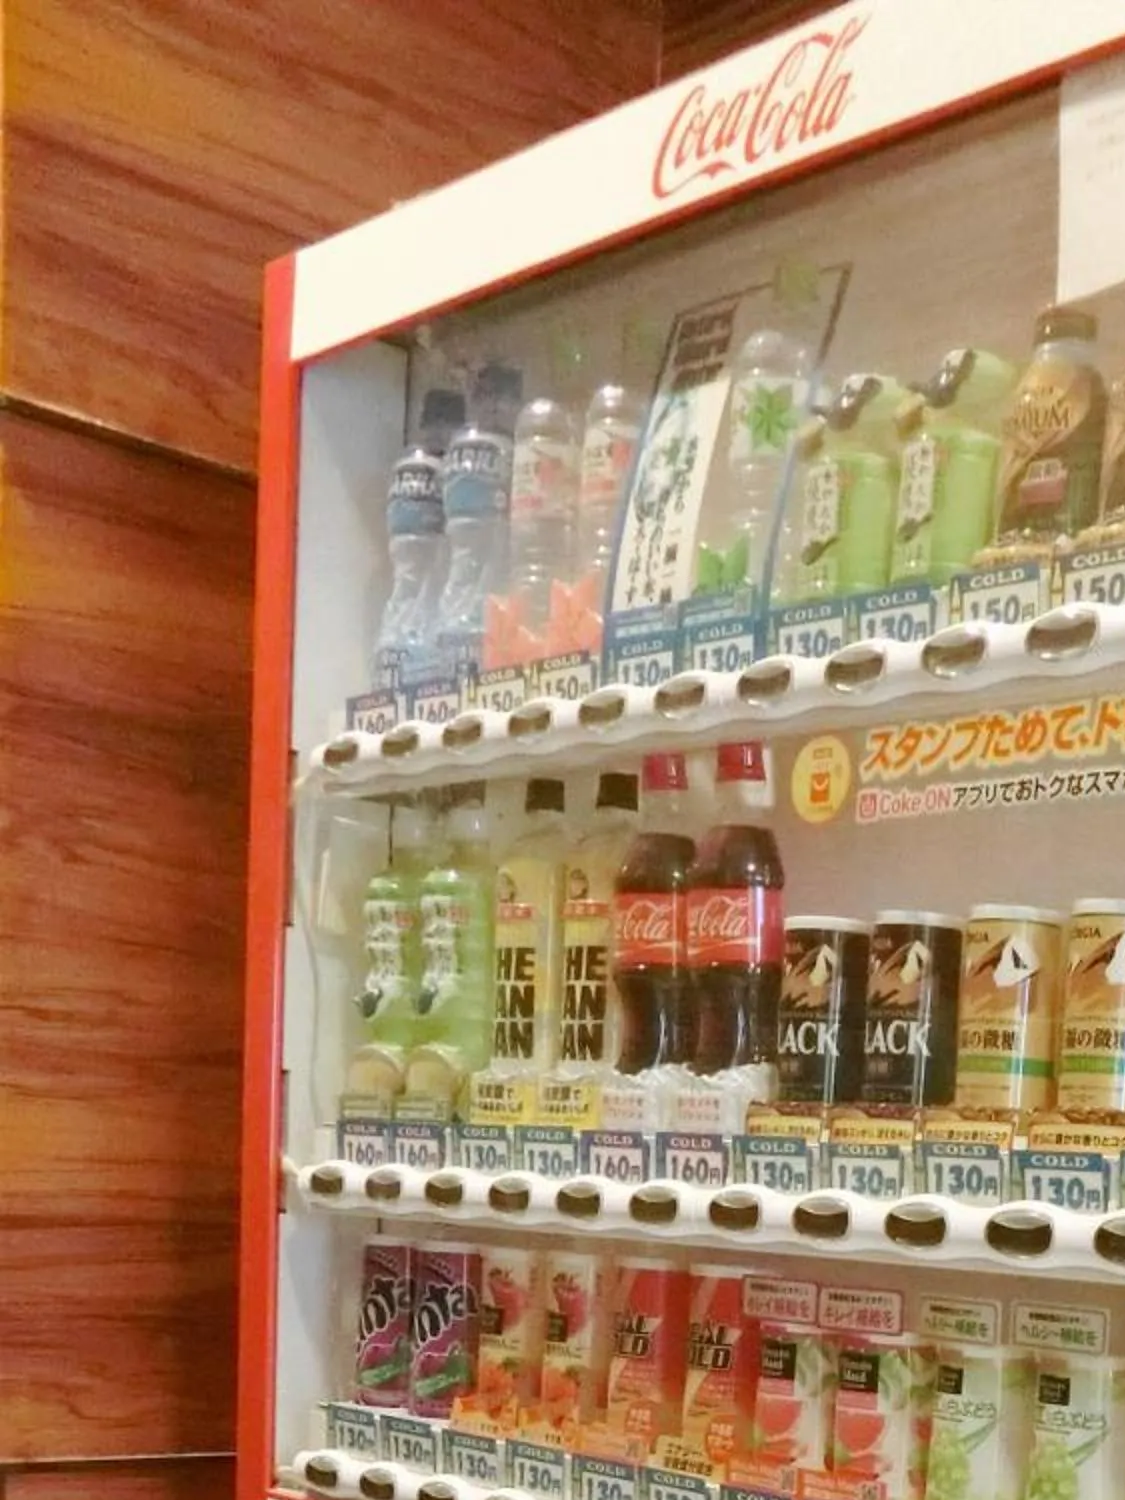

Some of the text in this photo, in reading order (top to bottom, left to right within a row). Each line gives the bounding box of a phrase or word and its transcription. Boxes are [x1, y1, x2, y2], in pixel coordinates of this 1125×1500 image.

[652, 12, 872, 198] Coca-Cola
[970, 568, 1025, 589] COLD
[866, 590, 918, 608] COLD
[783, 606, 831, 623] COLD
[699, 624, 743, 638] COLD
[594, 1133, 632, 1147] COLD
[670, 1136, 712, 1150] COLD
[749, 1140, 797, 1154] COLD
[838, 1144, 888, 1158] COLD
[933, 1144, 987, 1159] COLD
[1031, 1154, 1089, 1169] COLD
[838, 1163, 897, 1196] 130円
[933, 1162, 999, 1197] 130円
[1031, 1174, 1102, 1212] 130円
[654, 1473, 695, 1489] COLD
